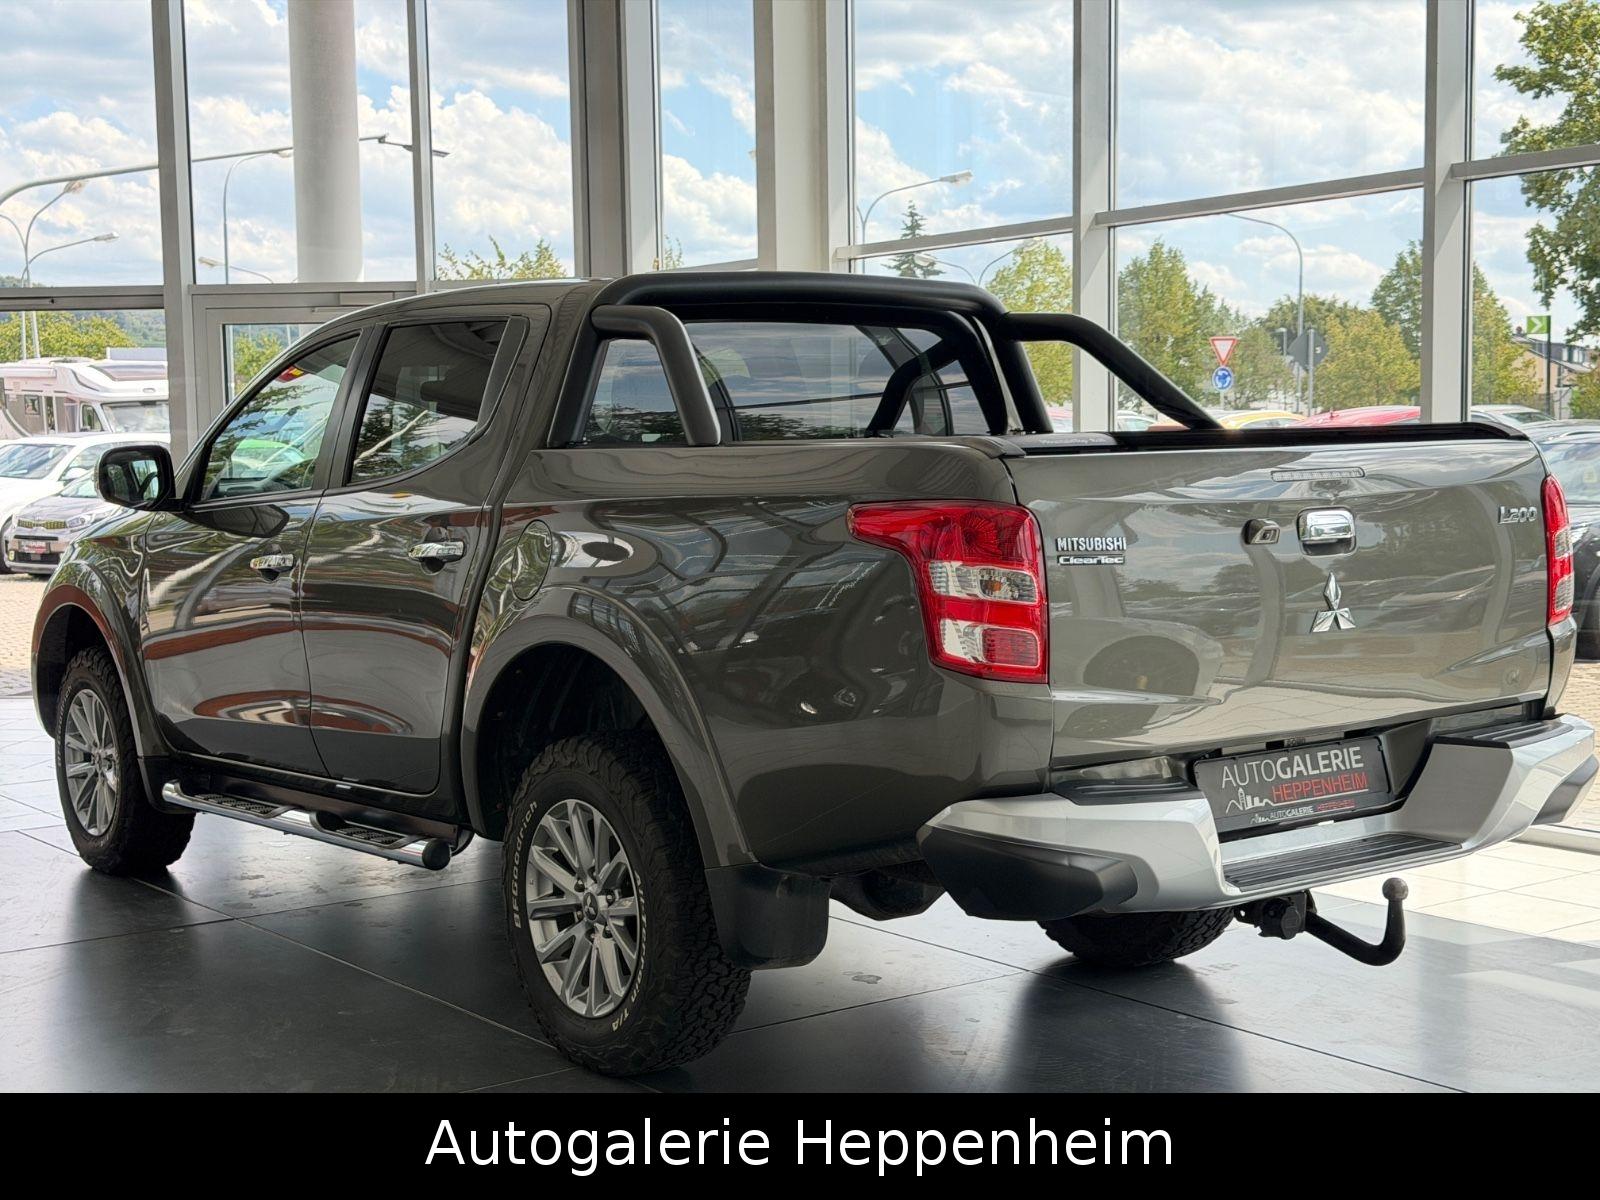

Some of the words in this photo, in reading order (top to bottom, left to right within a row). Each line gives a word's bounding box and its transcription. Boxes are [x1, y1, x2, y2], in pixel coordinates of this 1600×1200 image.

[1498, 506, 1538, 524] L200
[1056, 536, 1127, 551] MITSUBISHI
[1059, 555, 1124, 565] ClearTec
[1221, 746, 1364, 788] AUTOGALERIE
[1272, 771, 1369, 803] HEPPENHEIM
[511, 800, 538, 929] BFGoodrich
